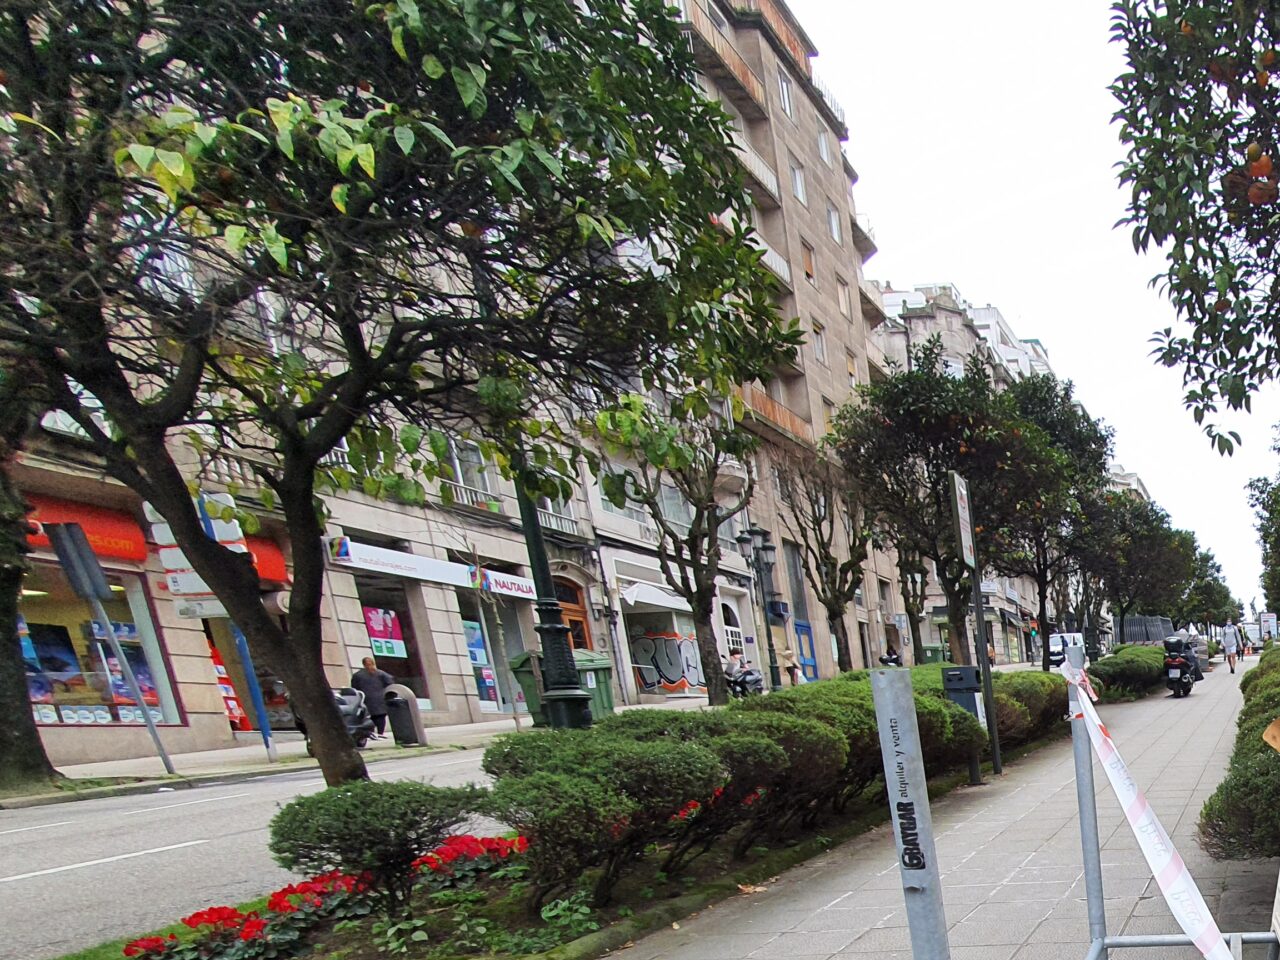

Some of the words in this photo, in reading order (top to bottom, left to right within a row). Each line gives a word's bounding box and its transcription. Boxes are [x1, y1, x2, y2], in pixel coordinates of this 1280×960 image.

[494, 579, 535, 595] NAUTALIA
[889, 718, 901, 748] venta
[895, 761, 909, 798] alquiler
